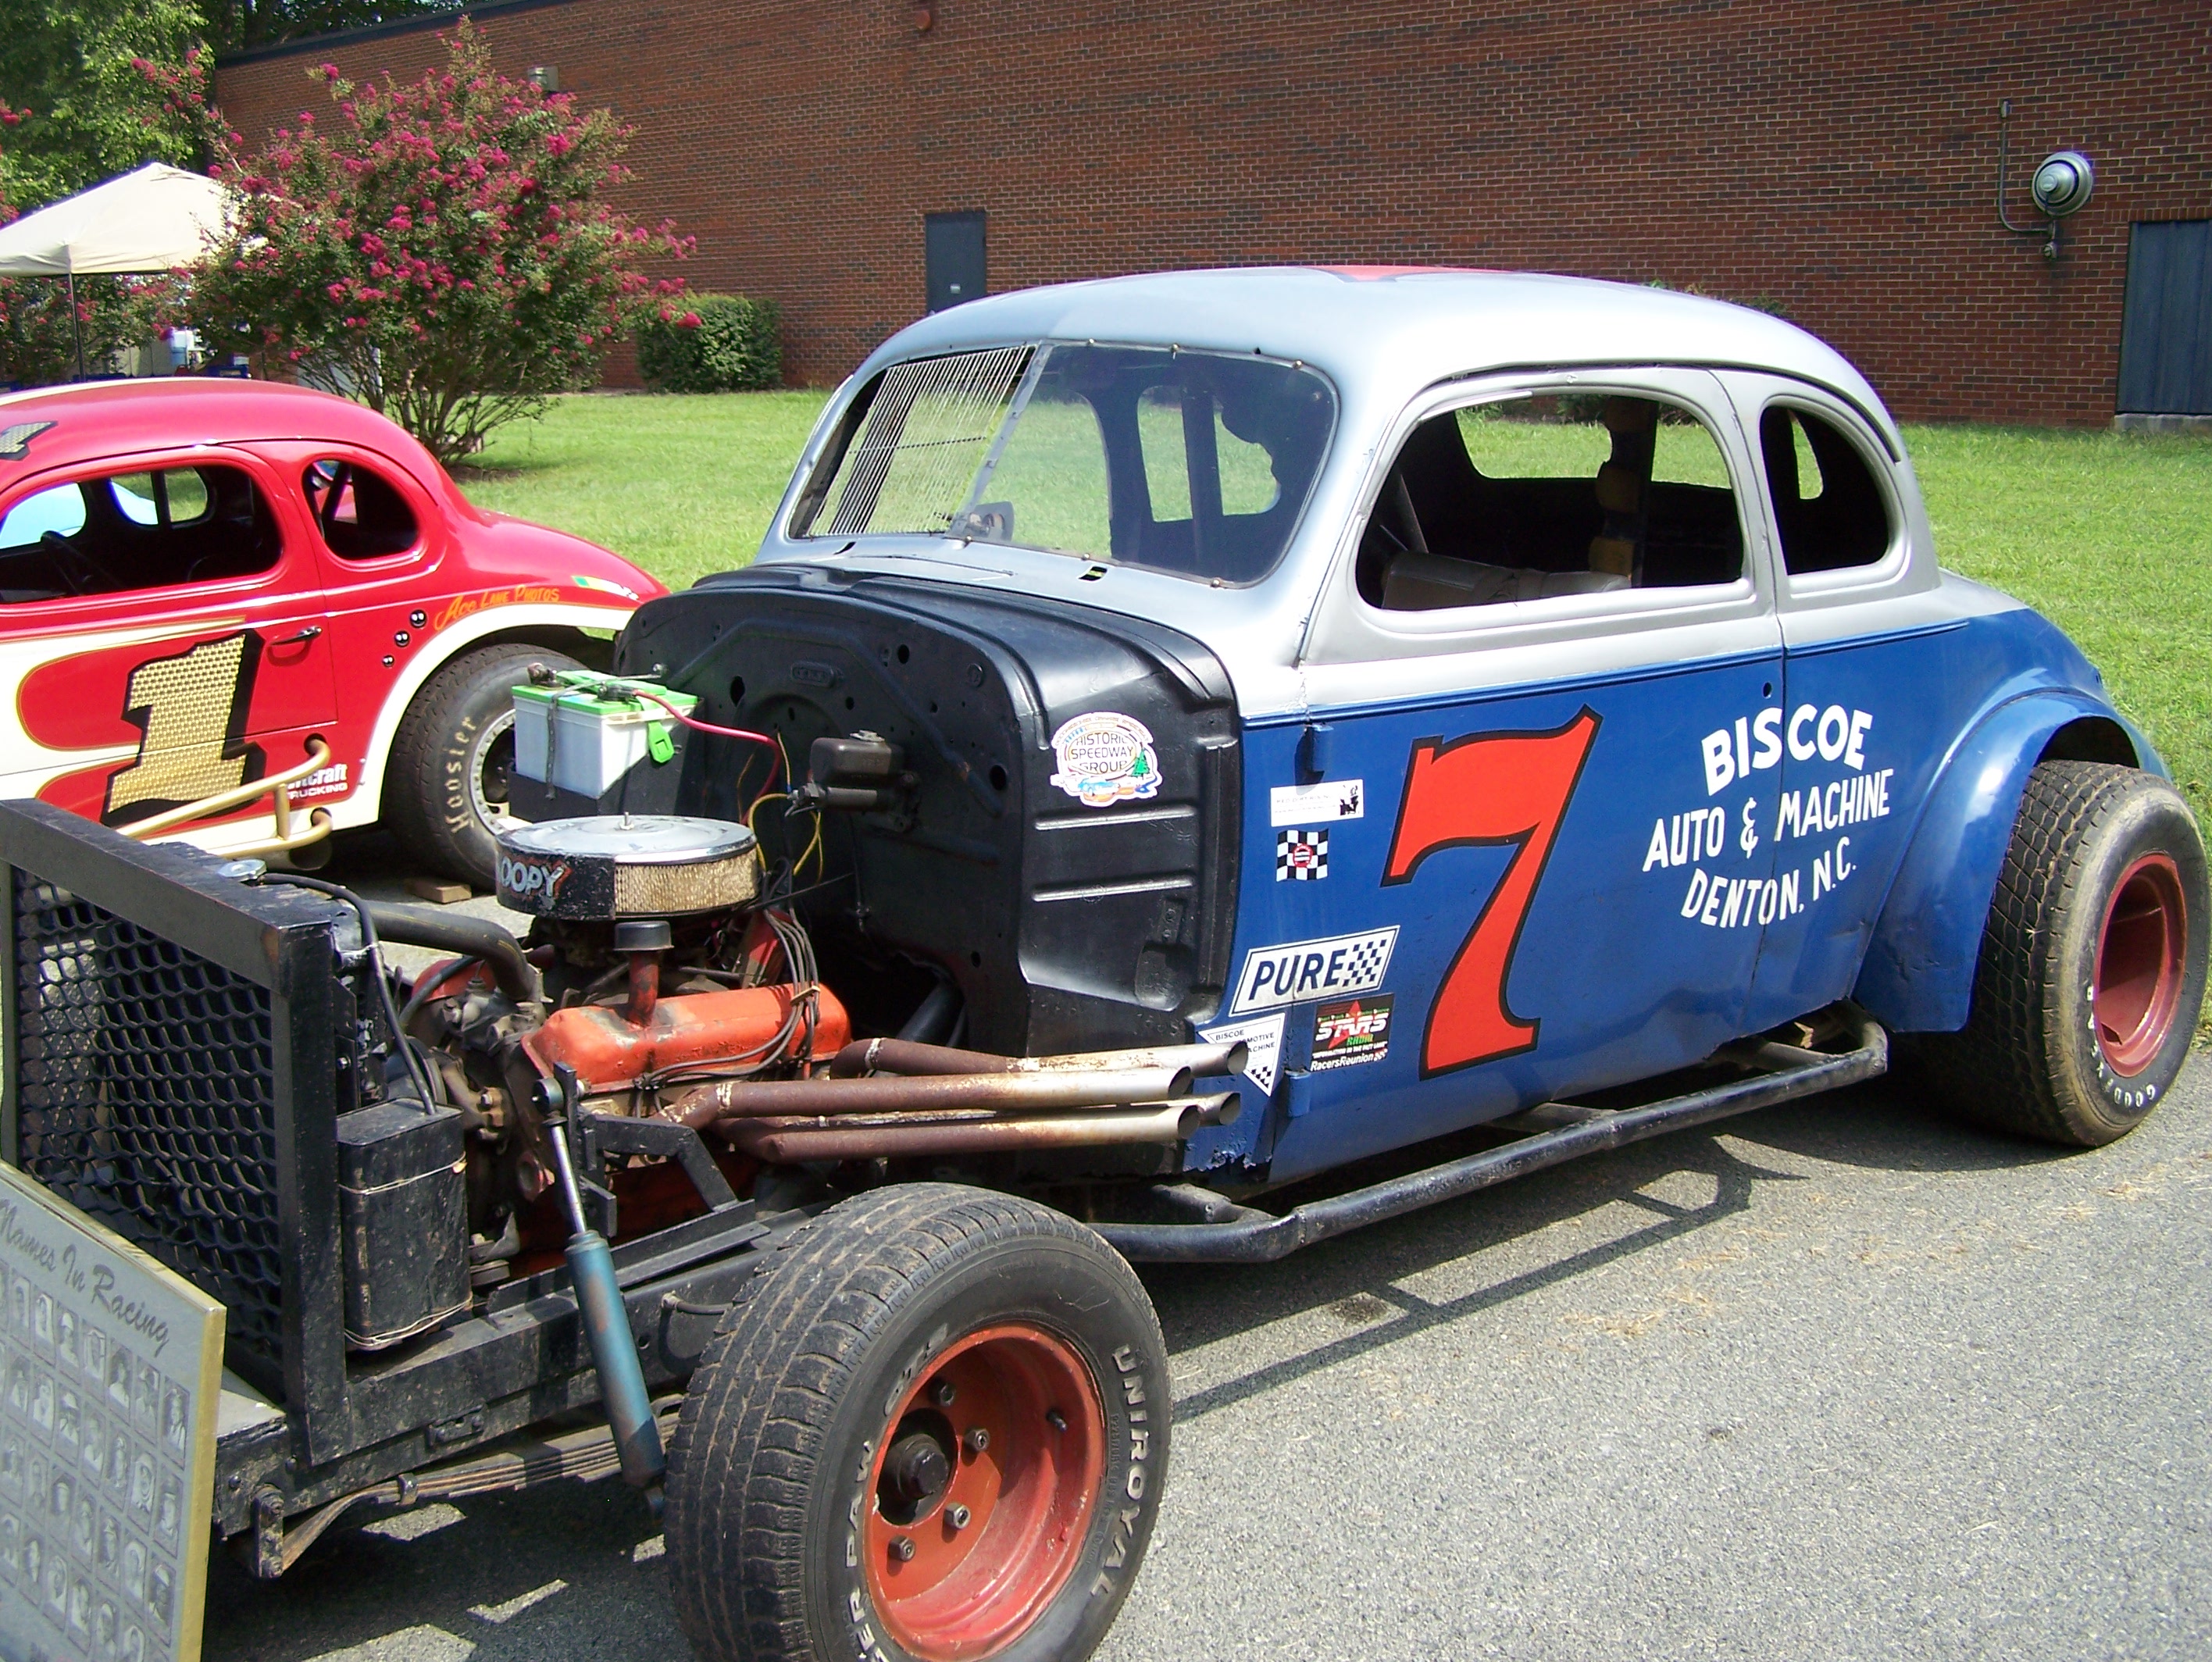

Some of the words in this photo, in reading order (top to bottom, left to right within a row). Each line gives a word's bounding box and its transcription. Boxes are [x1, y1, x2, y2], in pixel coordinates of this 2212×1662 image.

[102, 629, 264, 826] 1
[1076, 732, 1128, 746] HISTORIC
[1071, 746, 1134, 760] SPEEDWAY
[1701, 704, 1873, 796] BISCOE
[1079, 760, 1128, 774] GROUP
[287, 783, 348, 800] RUCKING
[1642, 806, 1725, 872] AUTO
[1739, 797, 1759, 859] &
[1774, 769, 1894, 842] MACHINE
[1380, 704, 1604, 1081] 7
[1249, 947, 1349, 1001] PURE
[1215, 1029, 1245, 1041] BISCOE
[1245, 1032, 1275, 1043] MOTIVE
[1315, 1012, 1389, 1042] STARS
[1247, 1041, 1275, 1053] ACHINE
[1310, 1053, 1374, 1072] RacersReunion
[63, 1243, 86, 1293] In
[91, 1264, 169, 1358] Racing
[1091, 1343, 1149, 1596] UNIROYAL
[846, 1440, 874, 1567] PAW
